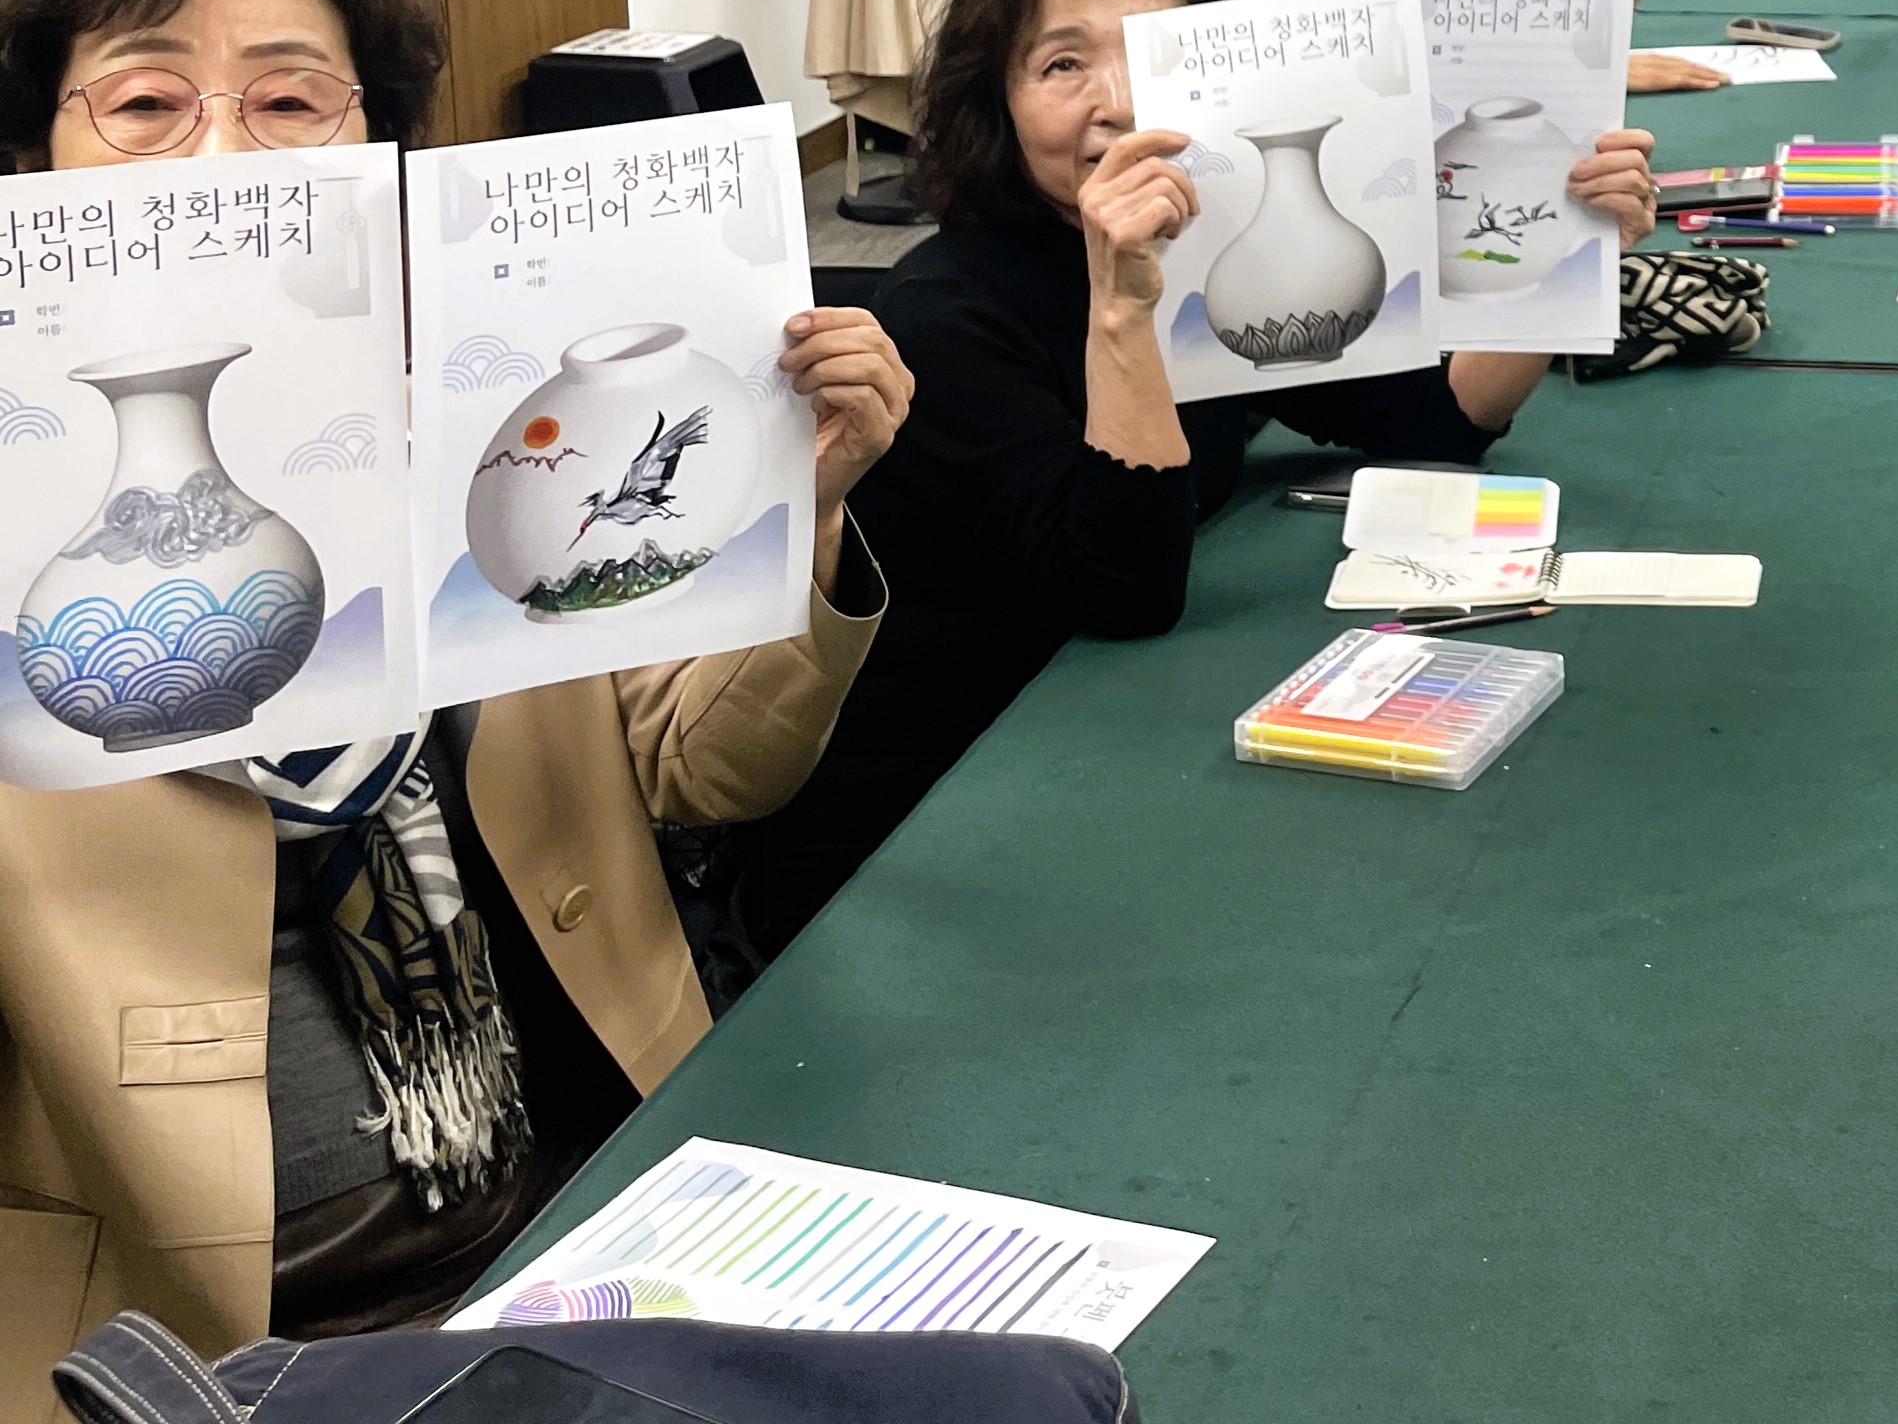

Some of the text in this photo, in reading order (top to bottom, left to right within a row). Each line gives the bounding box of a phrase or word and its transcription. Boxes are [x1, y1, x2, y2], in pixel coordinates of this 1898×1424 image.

[1179, 5, 1375, 52] 나만의 청화백자
[1434, 6, 1590, 34] 아이디어 스케치
[1185, 31, 1374, 77] 아이디어 스케치
[485, 141, 744, 207] 나만의 청화백자
[142, 180, 319, 231] 청화백자
[490, 176, 743, 243] 아이디어 스케치
[0, 219, 312, 288] 아이디어 스케치
